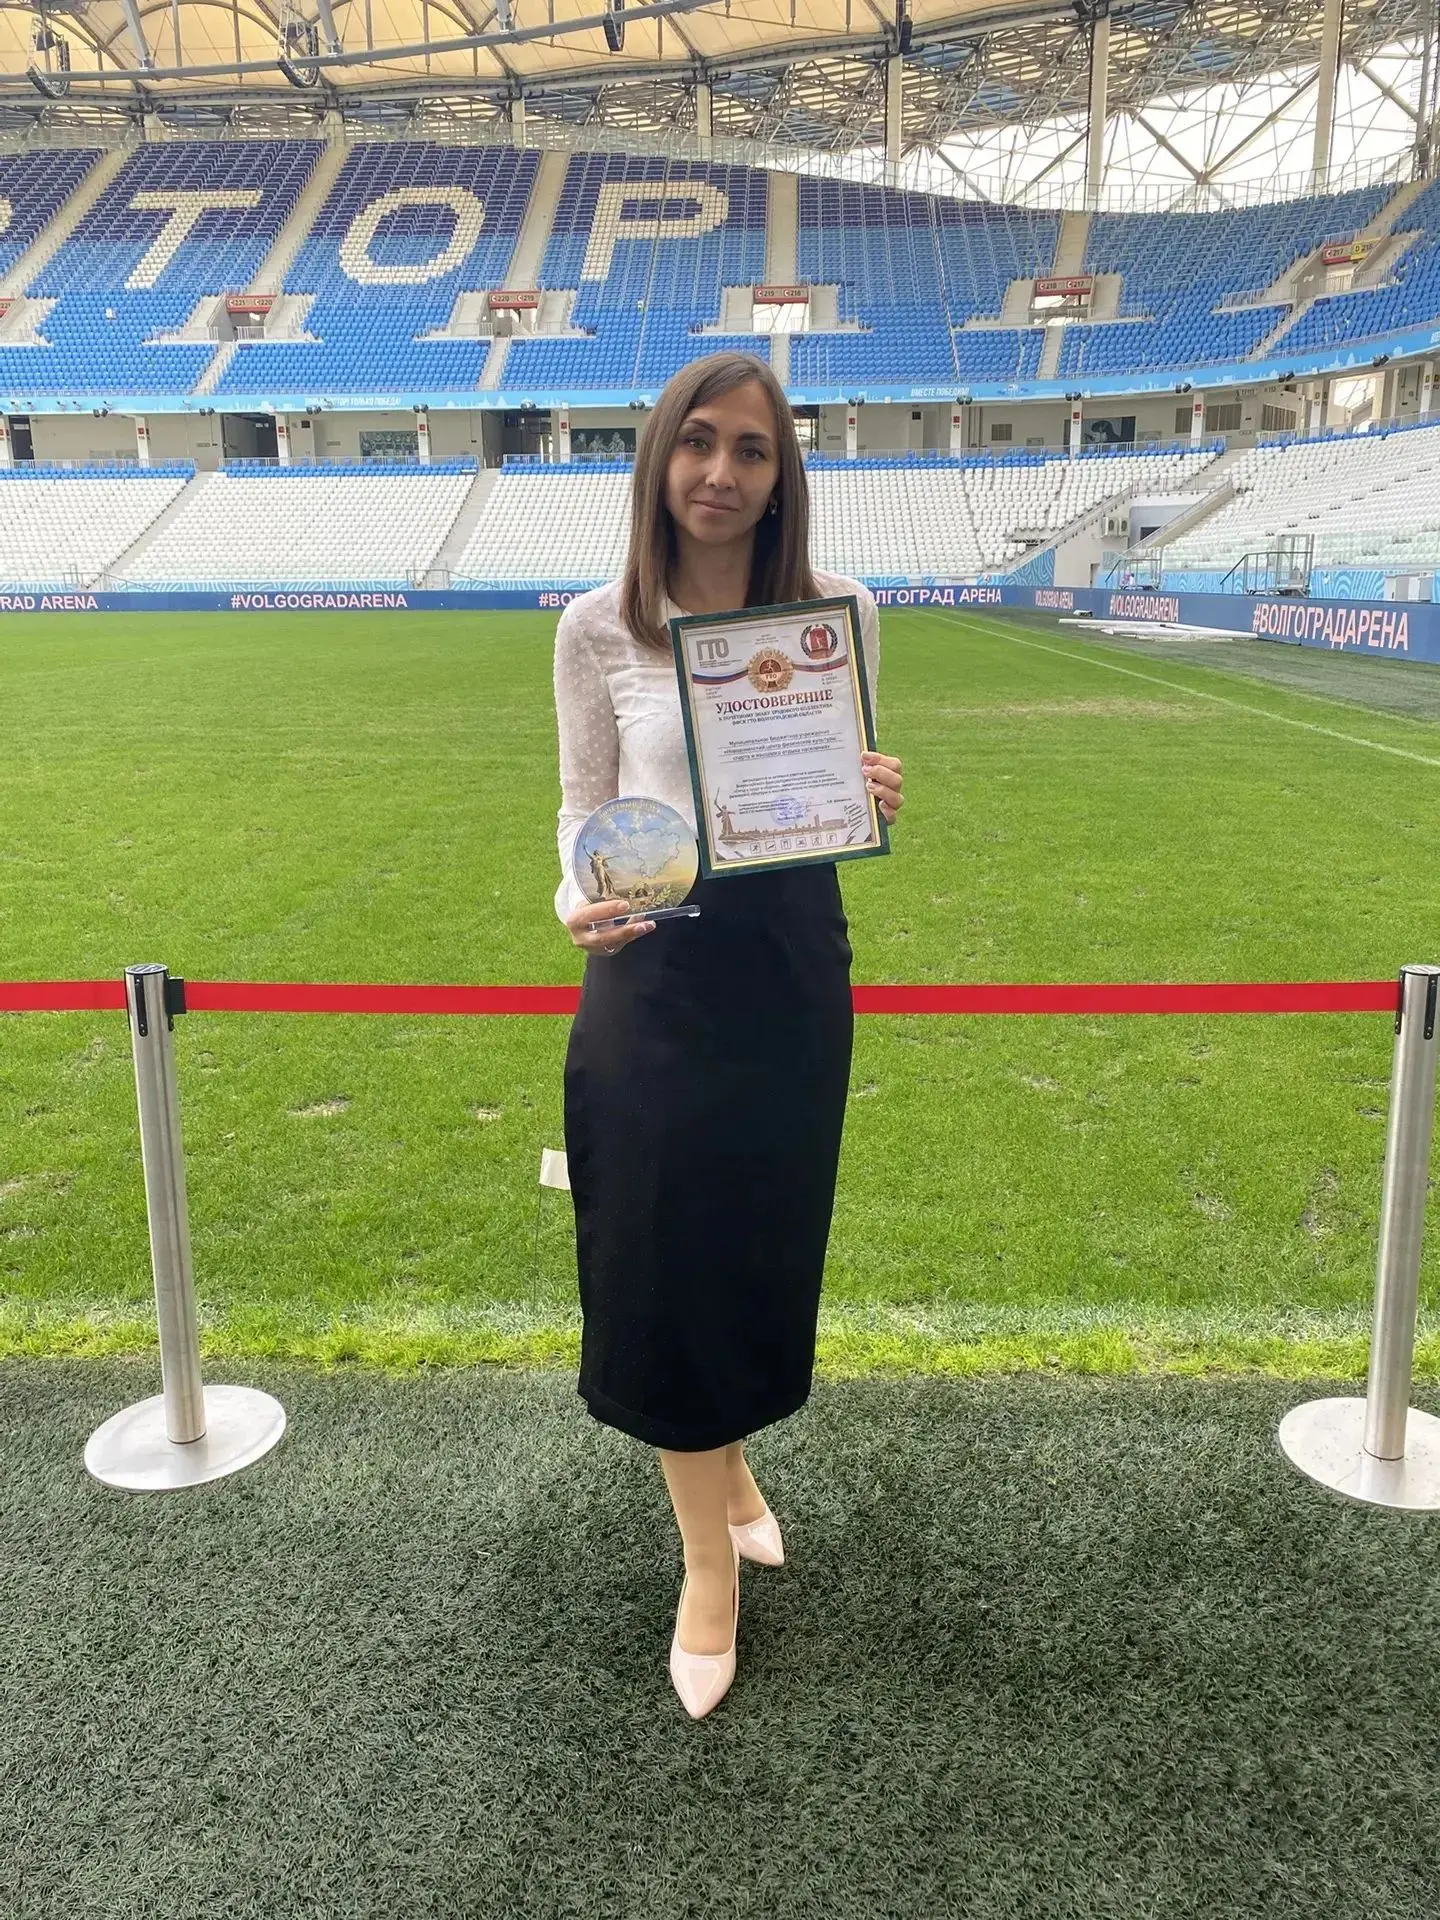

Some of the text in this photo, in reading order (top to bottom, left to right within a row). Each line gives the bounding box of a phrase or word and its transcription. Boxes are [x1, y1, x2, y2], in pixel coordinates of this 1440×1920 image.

[40, 595, 99, 610] ARENA
[231, 593, 408, 609] #VOLGOGRADARENA
[538, 592, 584, 607] #ВО
[958, 588, 1001, 603] АРЕНА
[1109, 594, 1179, 623] #VOLGOGRADARENA
[1252, 602, 1409, 651] #ВОЛГОГРАДАРЕНА
[696, 637, 730, 661] ГТО
[715, 689, 833, 714] УДОСТОВЕРЕНИЕ
